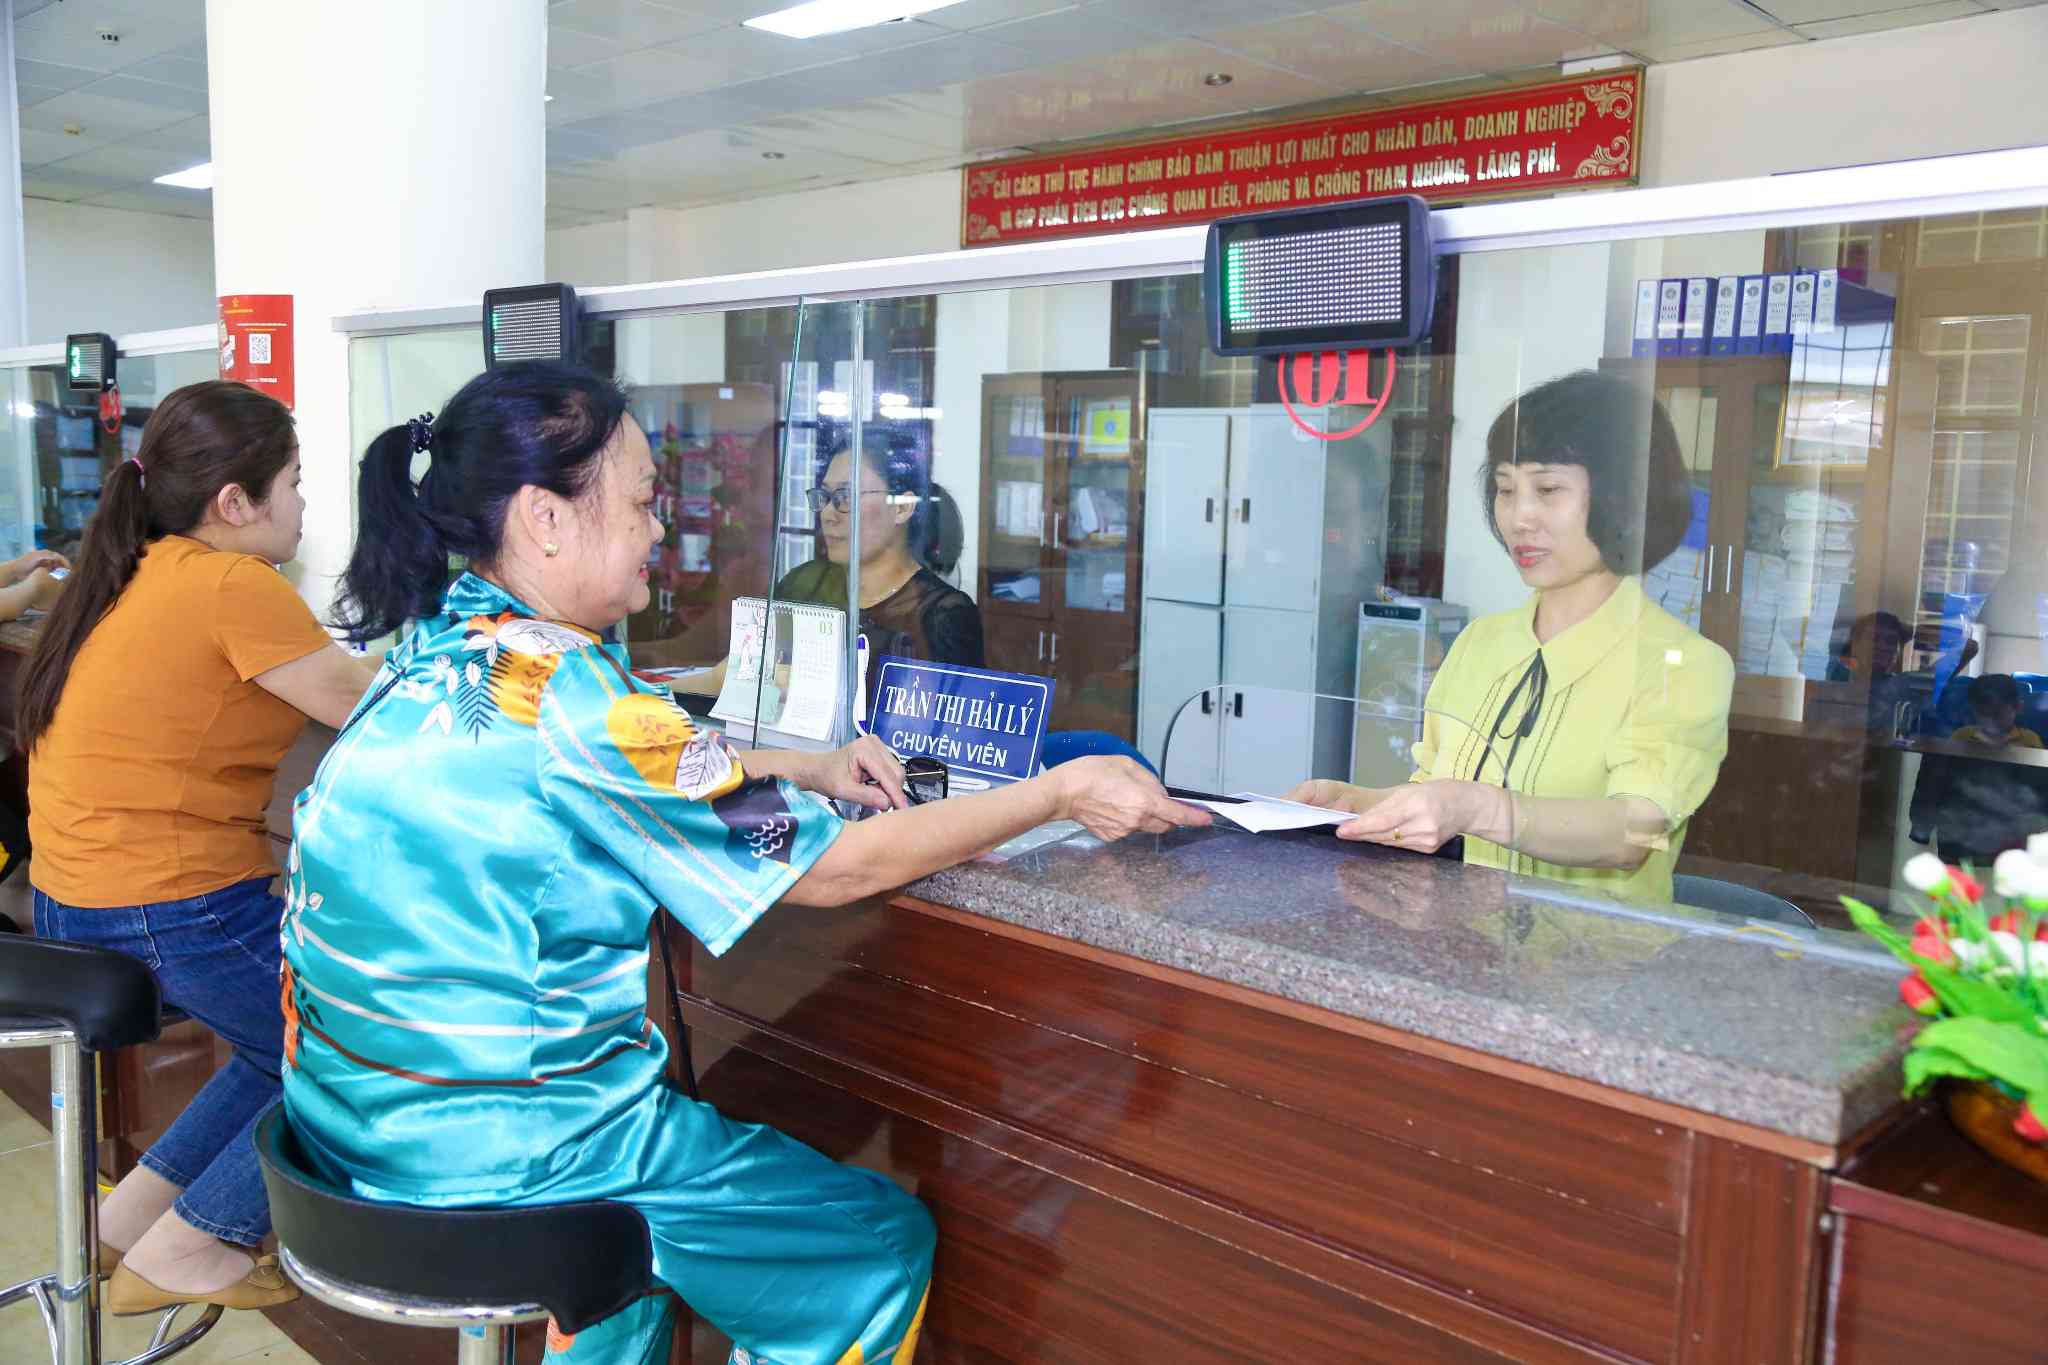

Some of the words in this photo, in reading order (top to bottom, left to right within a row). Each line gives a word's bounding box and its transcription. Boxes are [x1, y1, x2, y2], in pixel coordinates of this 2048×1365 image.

[1068, 168, 1089, 194] TỤC
[1092, 162, 1124, 188] HÀNH
[1127, 156, 1163, 183] CHÍNH
[1166, 147, 1191, 179] BẢO
[1195, 143, 1224, 175] ĐẢM
[1229, 140, 1271, 172] THUẬN
[1276, 138, 1297, 168] LỢI
[1302, 127, 1337, 162] NHẤT
[1342, 130, 1370, 156] CHO
[1375, 121, 1417, 152] NHÂN
[1422, 116, 1458, 146] DÂN,
[1464, 110, 1519, 141] DOANH
[1524, 97, 1586, 133] NGHIỆP
[1173, 187, 1206, 214] QUAN
[1210, 181, 1242, 209] LIÊU,
[1246, 175, 1290, 205] PHÒNG
[1295, 171, 1311, 199] VÀ
[1315, 163, 1361, 197] CHỐNG
[1366, 164, 1408, 192] THAM
[1411, 156, 1470, 189] NHŨNG,
[1476, 150, 1521, 181] LÃNG
[1526, 141, 1561, 176] PHÍ.
[884, 676, 932, 719] TRẦN
[933, 693, 968, 733] THỊ
[966, 691, 1004, 731] HẢI
[1004, 698, 1035, 736] LÝ
[892, 730, 962, 760] CHUYÊN
[966, 741, 1008, 768] VIÊN
